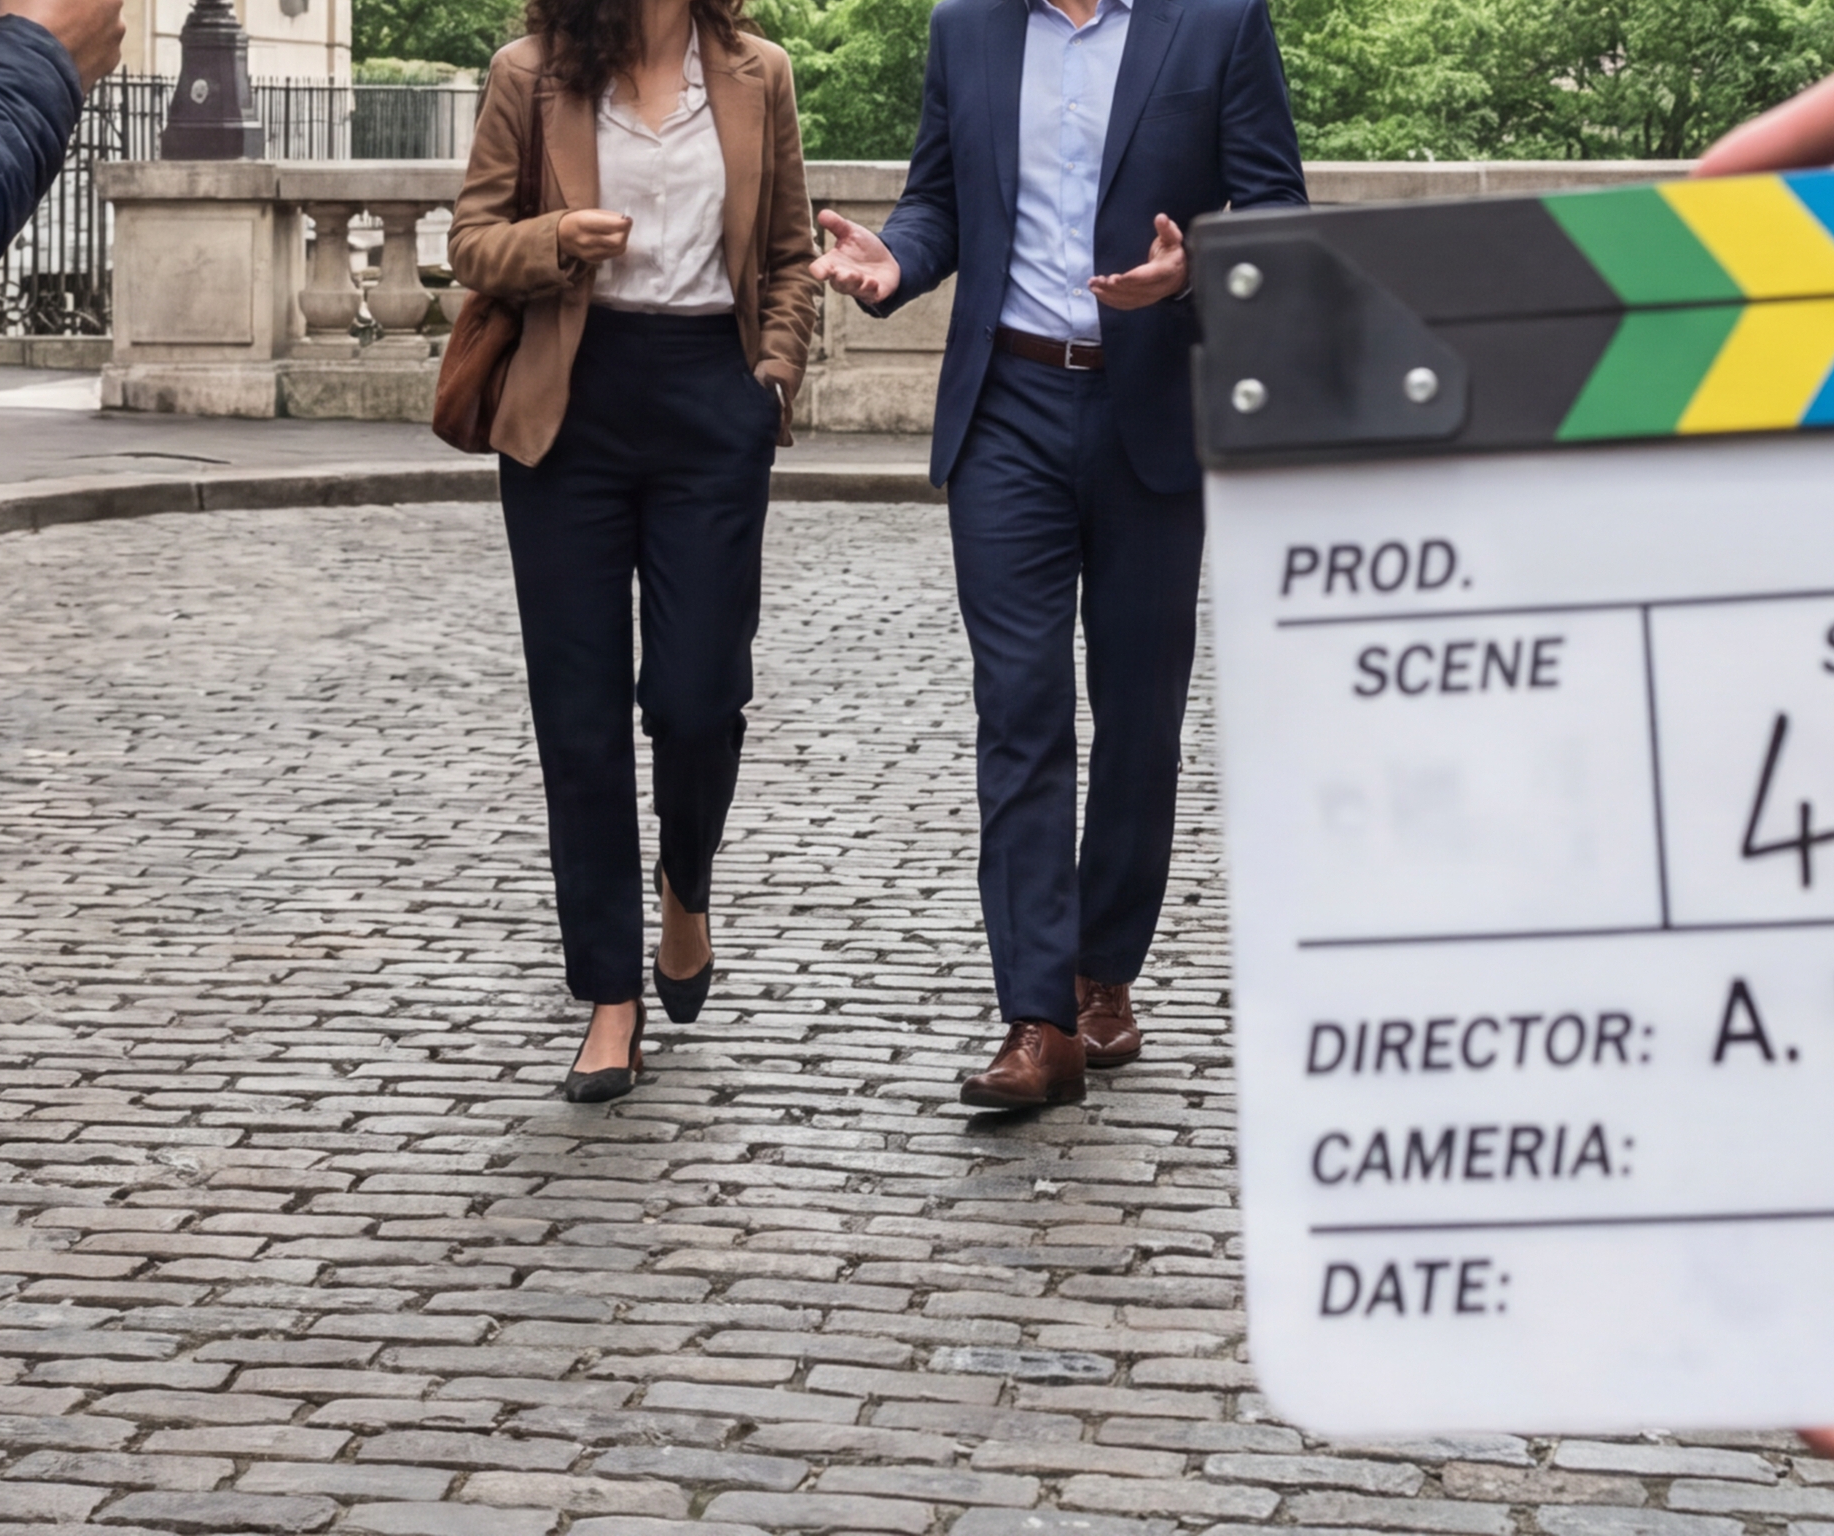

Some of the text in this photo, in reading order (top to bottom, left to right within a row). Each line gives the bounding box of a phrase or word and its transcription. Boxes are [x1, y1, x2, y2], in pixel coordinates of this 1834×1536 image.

[1279, 538, 1473, 598] PROD.
[1353, 636, 1565, 699] SCENE
[1305, 1011, 1653, 1077] DIRECTOR:
[1711, 976, 1800, 1066] A.
[1310, 1122, 1634, 1187] CAMERIA:
[1319, 1258, 1510, 1318] DATE:
